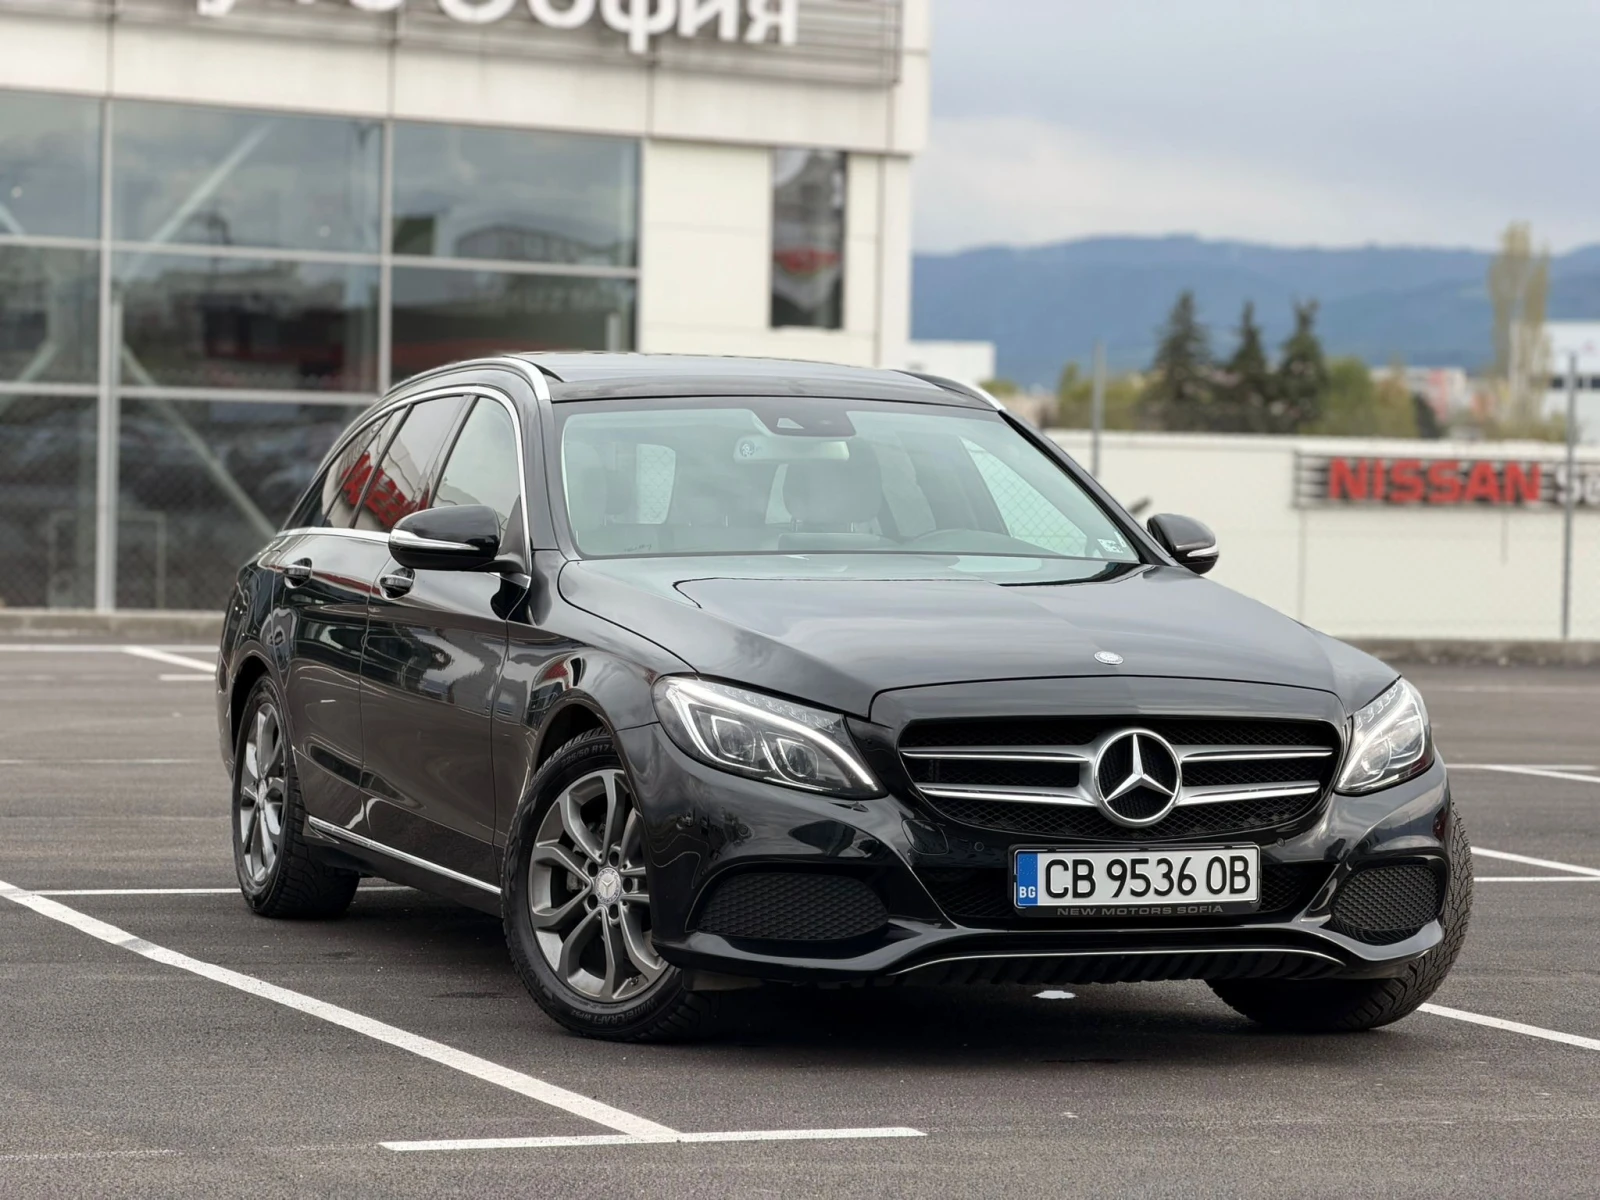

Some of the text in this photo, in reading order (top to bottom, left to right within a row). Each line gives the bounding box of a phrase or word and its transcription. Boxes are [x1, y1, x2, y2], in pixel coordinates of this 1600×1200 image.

[1329, 456, 1541, 504] NISSAN
[1045, 858, 1096, 899] CB
[1106, 856, 1197, 898] 9536
[1019, 886, 1036, 899] BG
[1056, 904, 1224, 916] NEW MOTORS SOFIA
